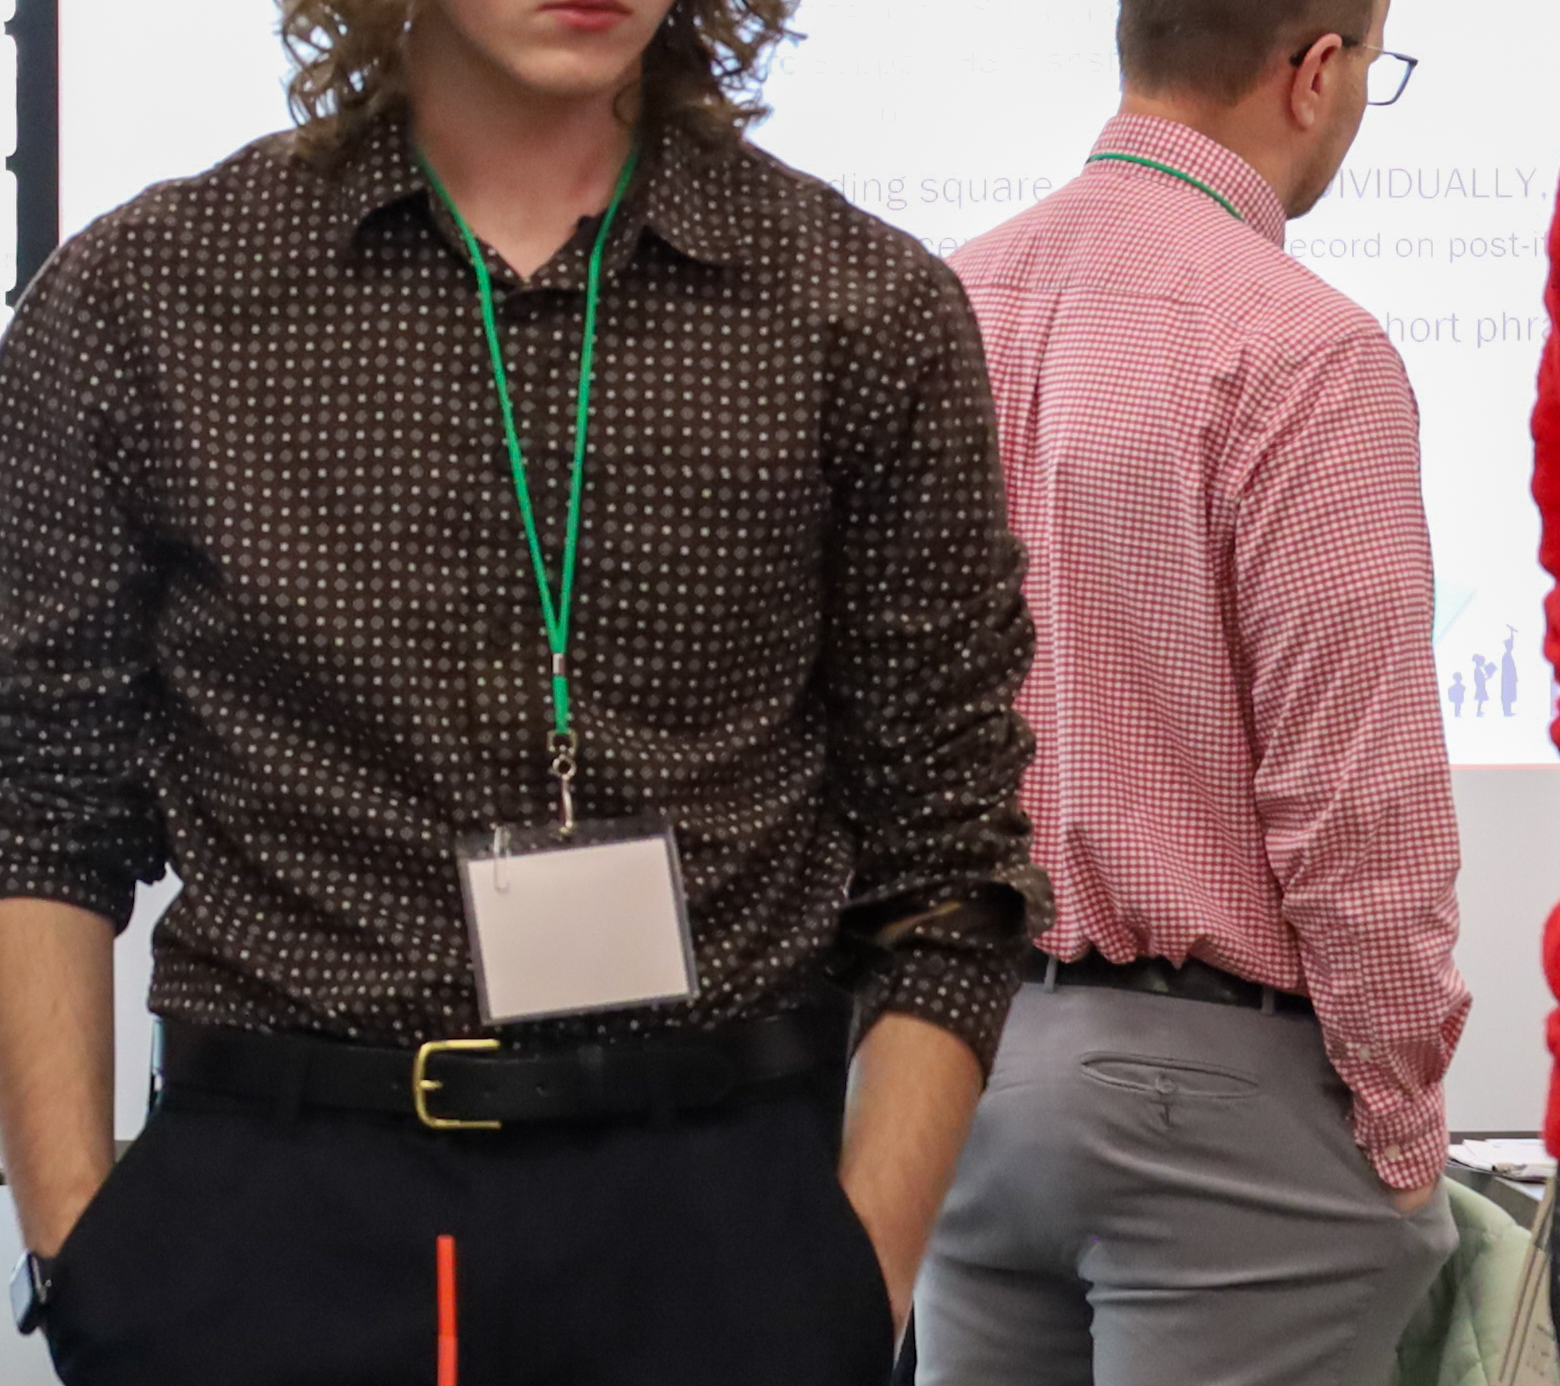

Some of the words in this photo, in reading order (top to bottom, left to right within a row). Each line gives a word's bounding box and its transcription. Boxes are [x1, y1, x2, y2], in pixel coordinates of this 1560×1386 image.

[835, 171, 908, 212] ding
[920, 175, 1053, 210] square
[1285, 232, 1382, 259] ecord
[1395, 237, 1434, 259] on
[1386, 311, 1462, 344] hort
